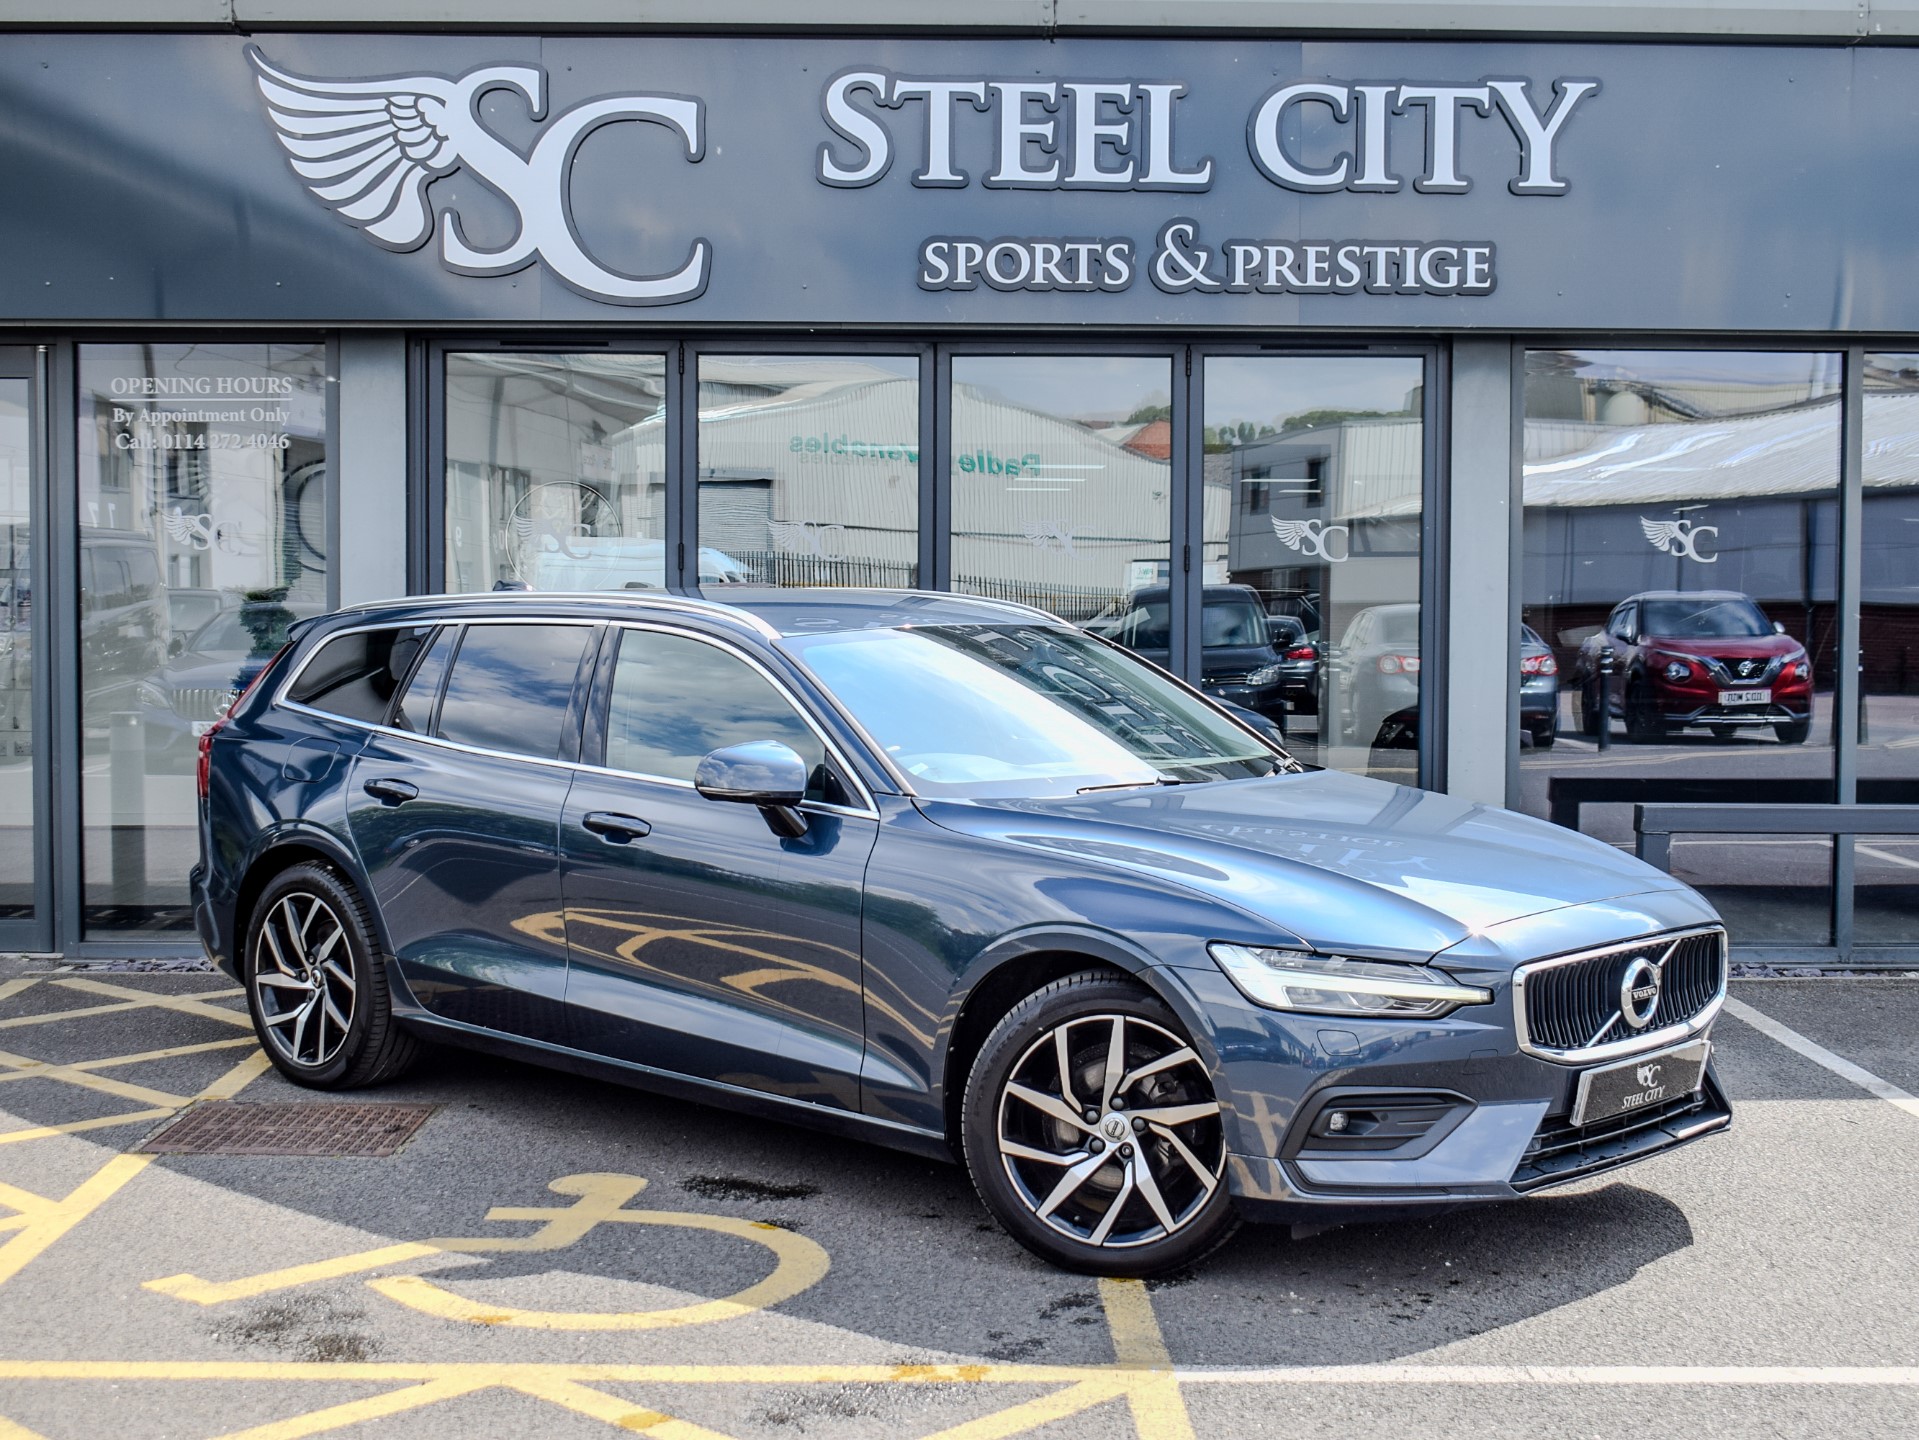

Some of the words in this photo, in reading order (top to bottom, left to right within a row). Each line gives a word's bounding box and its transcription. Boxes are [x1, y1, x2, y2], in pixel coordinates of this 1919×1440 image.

[820, 71, 1212, 187] STEEL
[1253, 76, 1598, 190] CITY
[921, 239, 1134, 289] SPORTS
[1154, 221, 1222, 290] &
[1228, 242, 1494, 292] PRESTIGE
[111, 377, 211, 394] OPENING
[216, 377, 293, 394] HOURS
[113, 408, 134, 426] By
[139, 408, 246, 426] Appointment
[250, 407, 291, 425] Only
[115, 433, 157, 449] Call:
[161, 433, 205, 449] 0114
[209, 433, 242, 449] 272
[247, 433, 290, 449] 4046
[1632, 987, 1657, 999] VOLVO
[1622, 1092, 1644, 1109] STEEL
[1645, 1086, 1665, 1101] CITY
